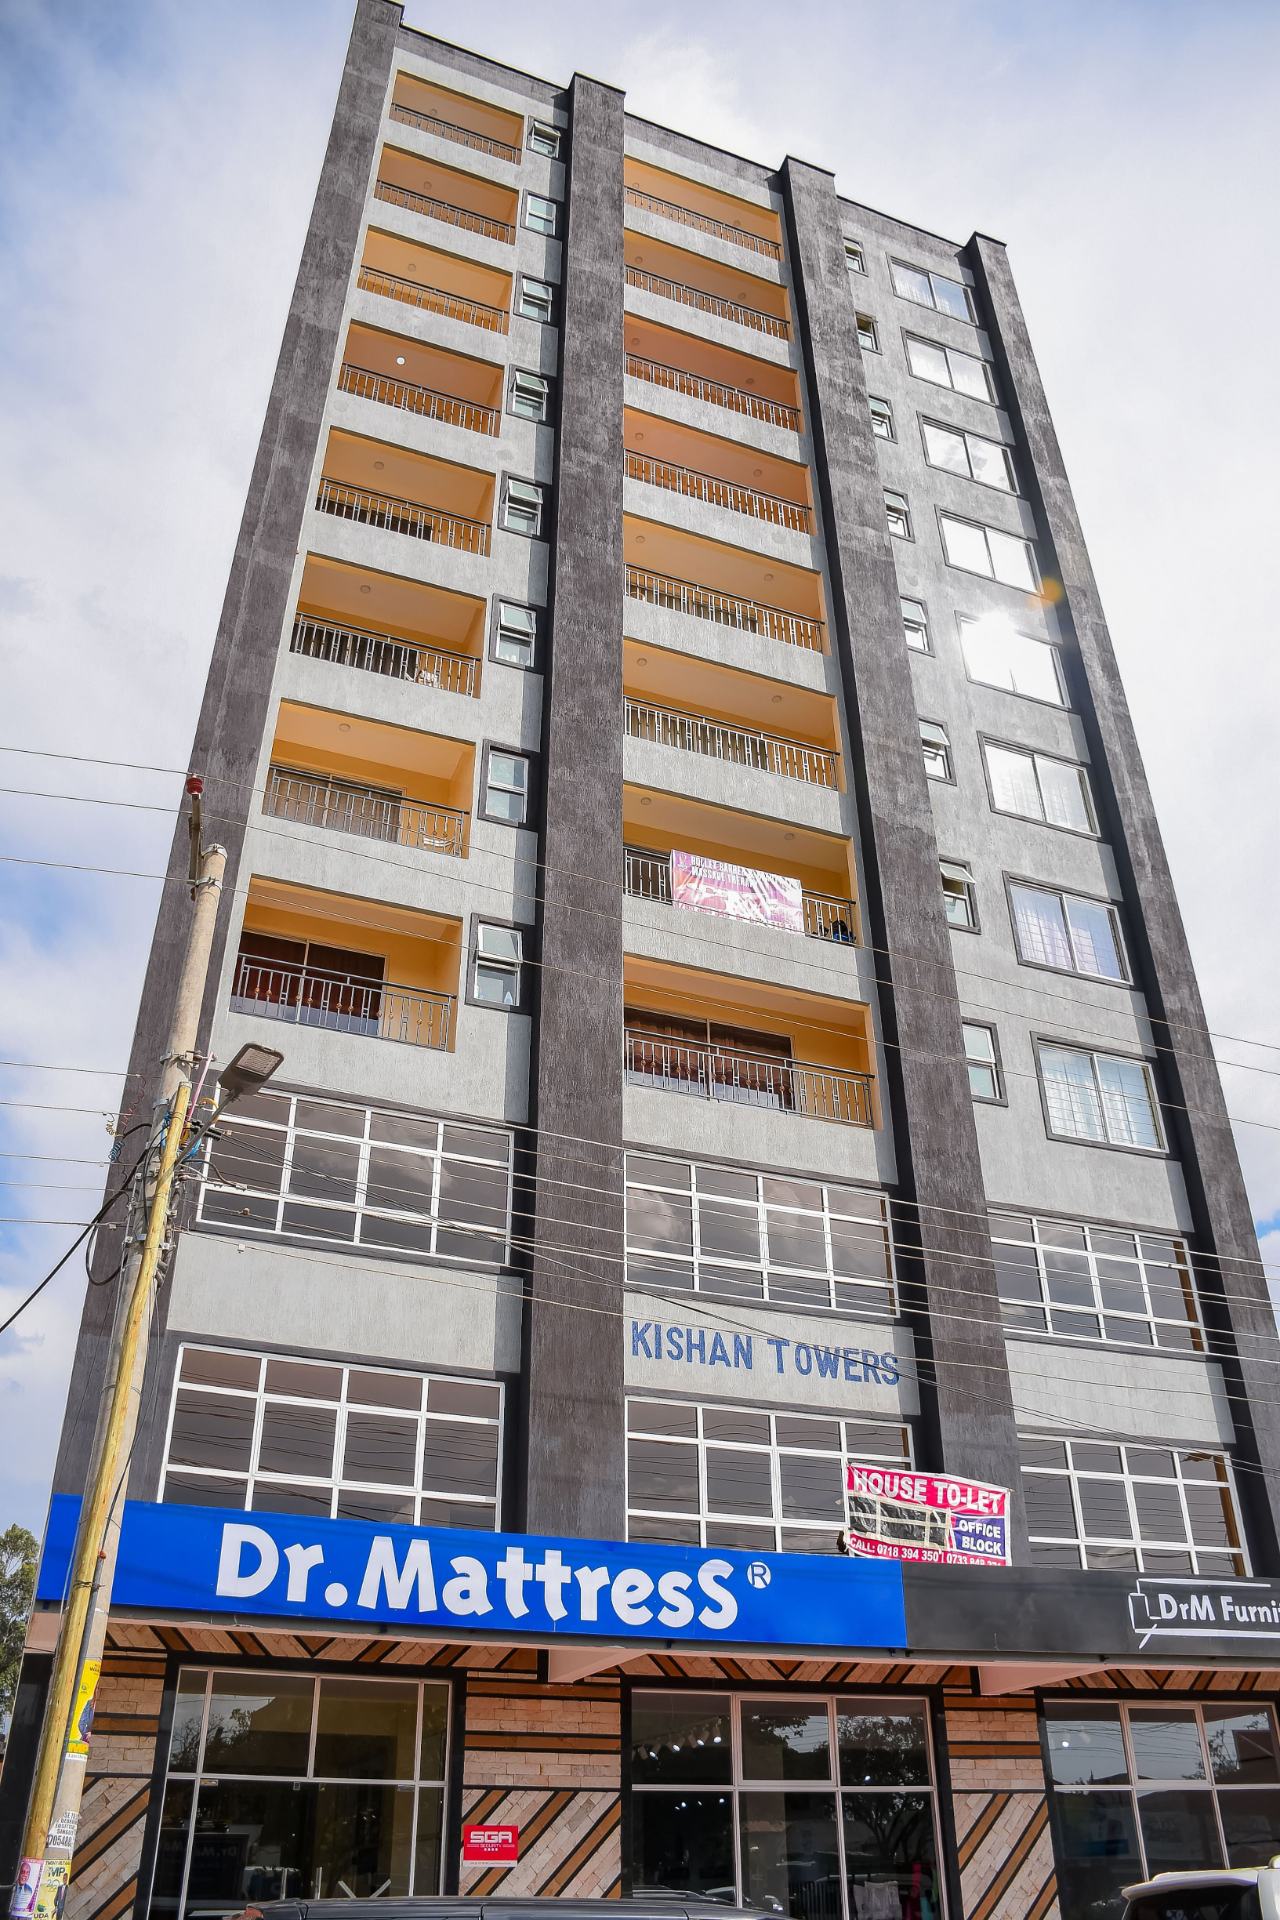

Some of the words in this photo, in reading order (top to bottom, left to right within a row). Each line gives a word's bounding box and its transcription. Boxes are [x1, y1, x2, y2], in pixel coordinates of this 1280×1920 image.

[632, 1320, 753, 1370] KISHAN
[766, 1338, 900, 1386] TOWERS
[853, 1470, 927, 1502] HOUSE
[933, 1481, 1001, 1514] TO-LET
[959, 1519, 1001, 1539] OFFICE
[850, 1538, 875, 1552] CALL:
[877, 1544, 899, 1557] 0718
[901, 1548, 919, 1559] 394
[921, 1550, 939, 1562] 350
[961, 1536, 1002, 1555] BLOCK
[1158, 1593, 1216, 1621] DrM
[1220, 1595, 1280, 1623] Furni
[470, 1831, 512, 1844] SGA
